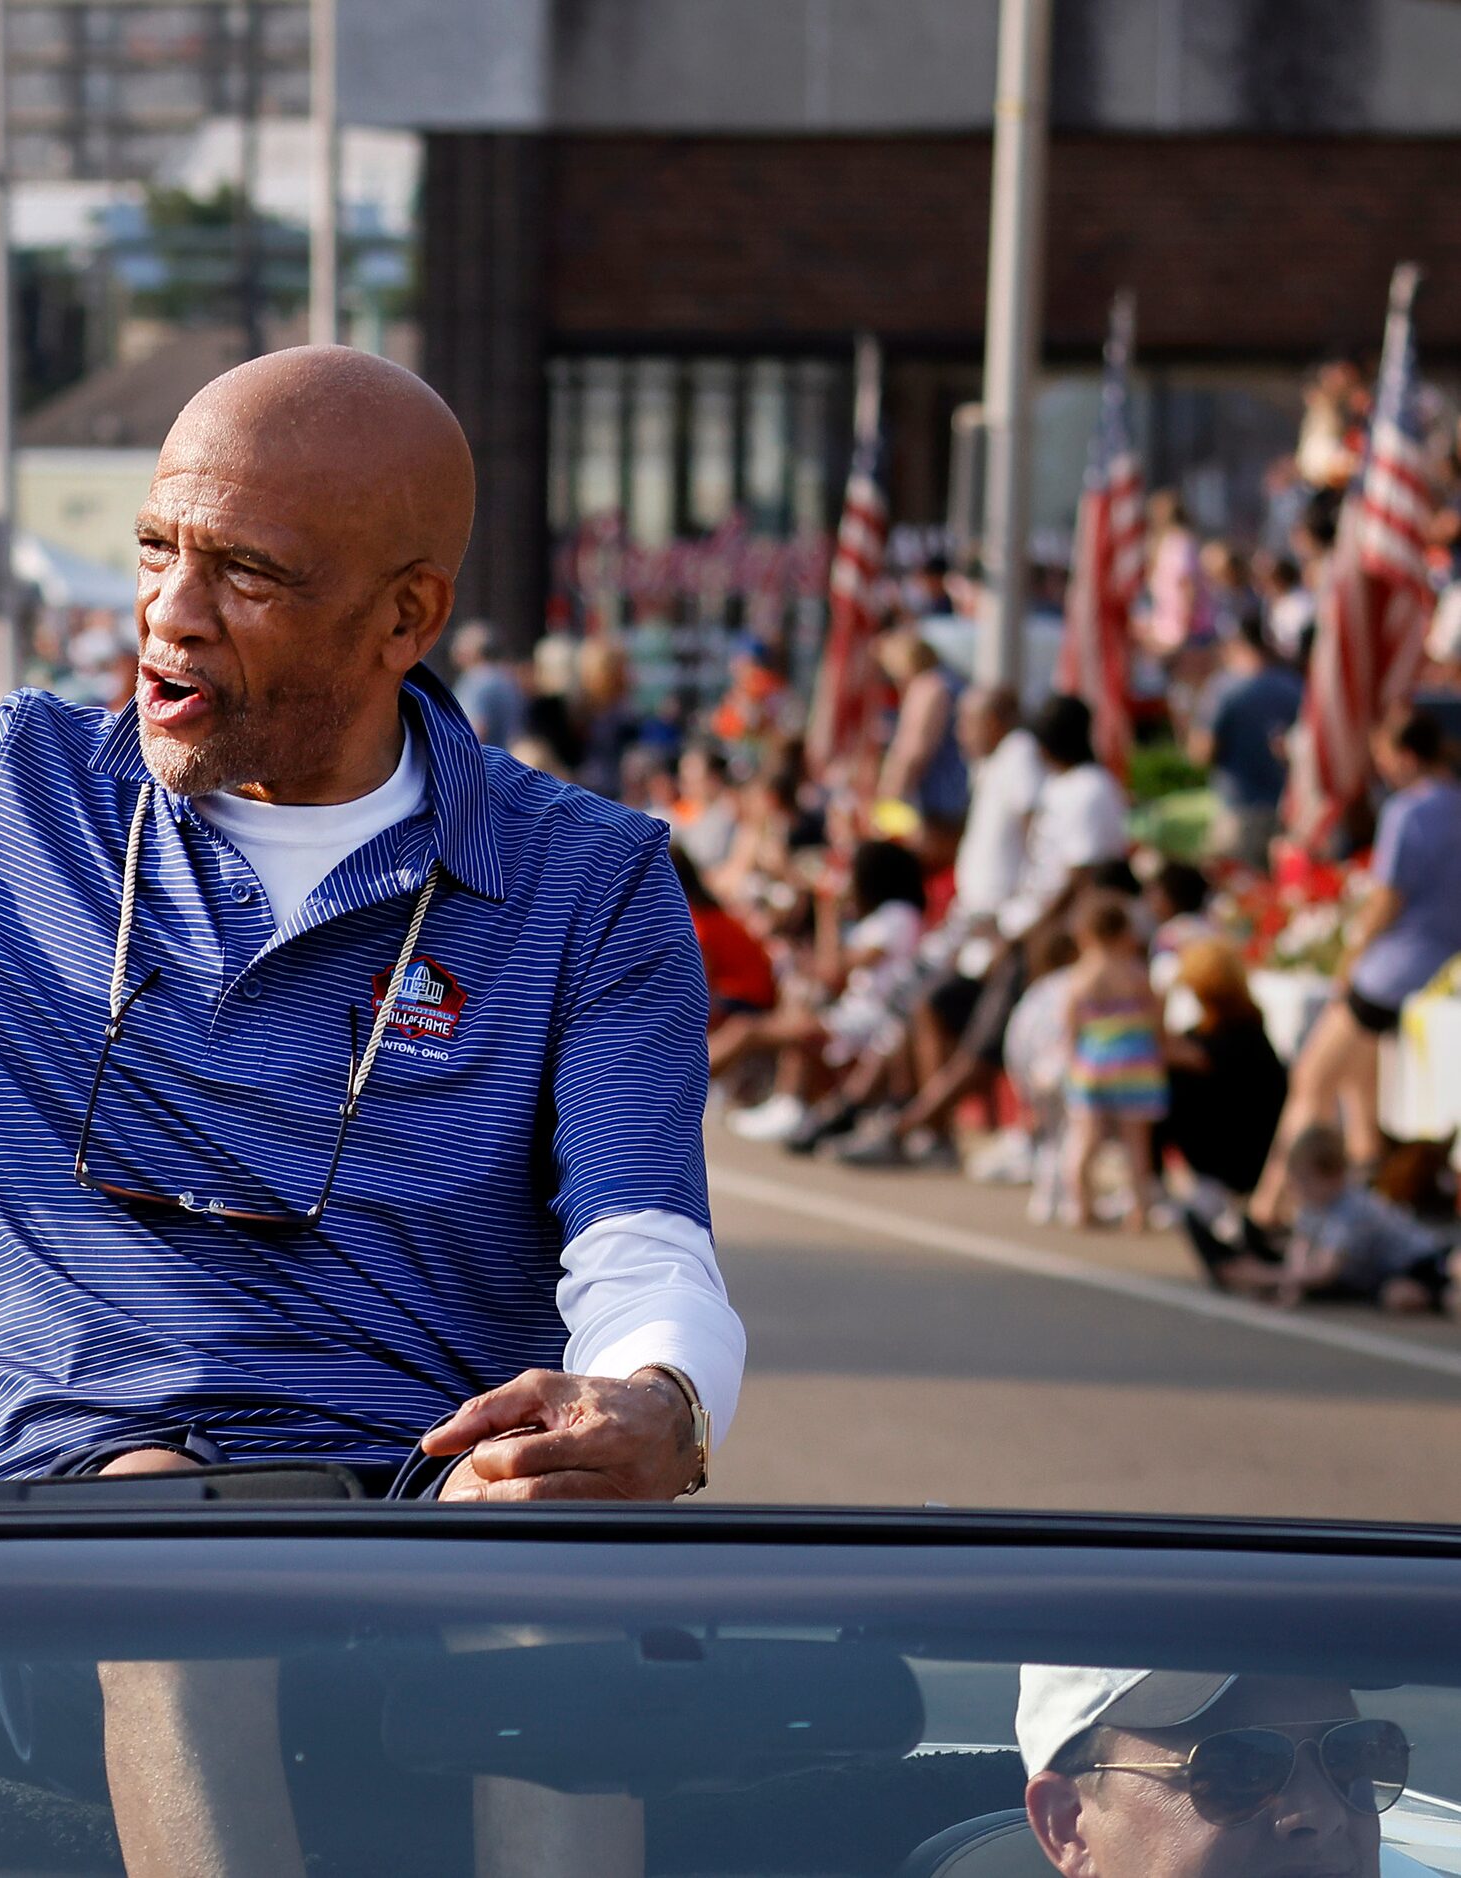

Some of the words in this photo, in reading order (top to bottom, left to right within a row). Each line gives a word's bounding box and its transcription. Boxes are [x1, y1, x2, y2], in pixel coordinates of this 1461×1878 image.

[387, 1010, 410, 1025] ALL
[408, 1015, 418, 1023] OF
[417, 1016, 451, 1036] FAME
[379, 1040, 418, 1056] ANTON,
[421, 1048, 449, 1061] OHIO
